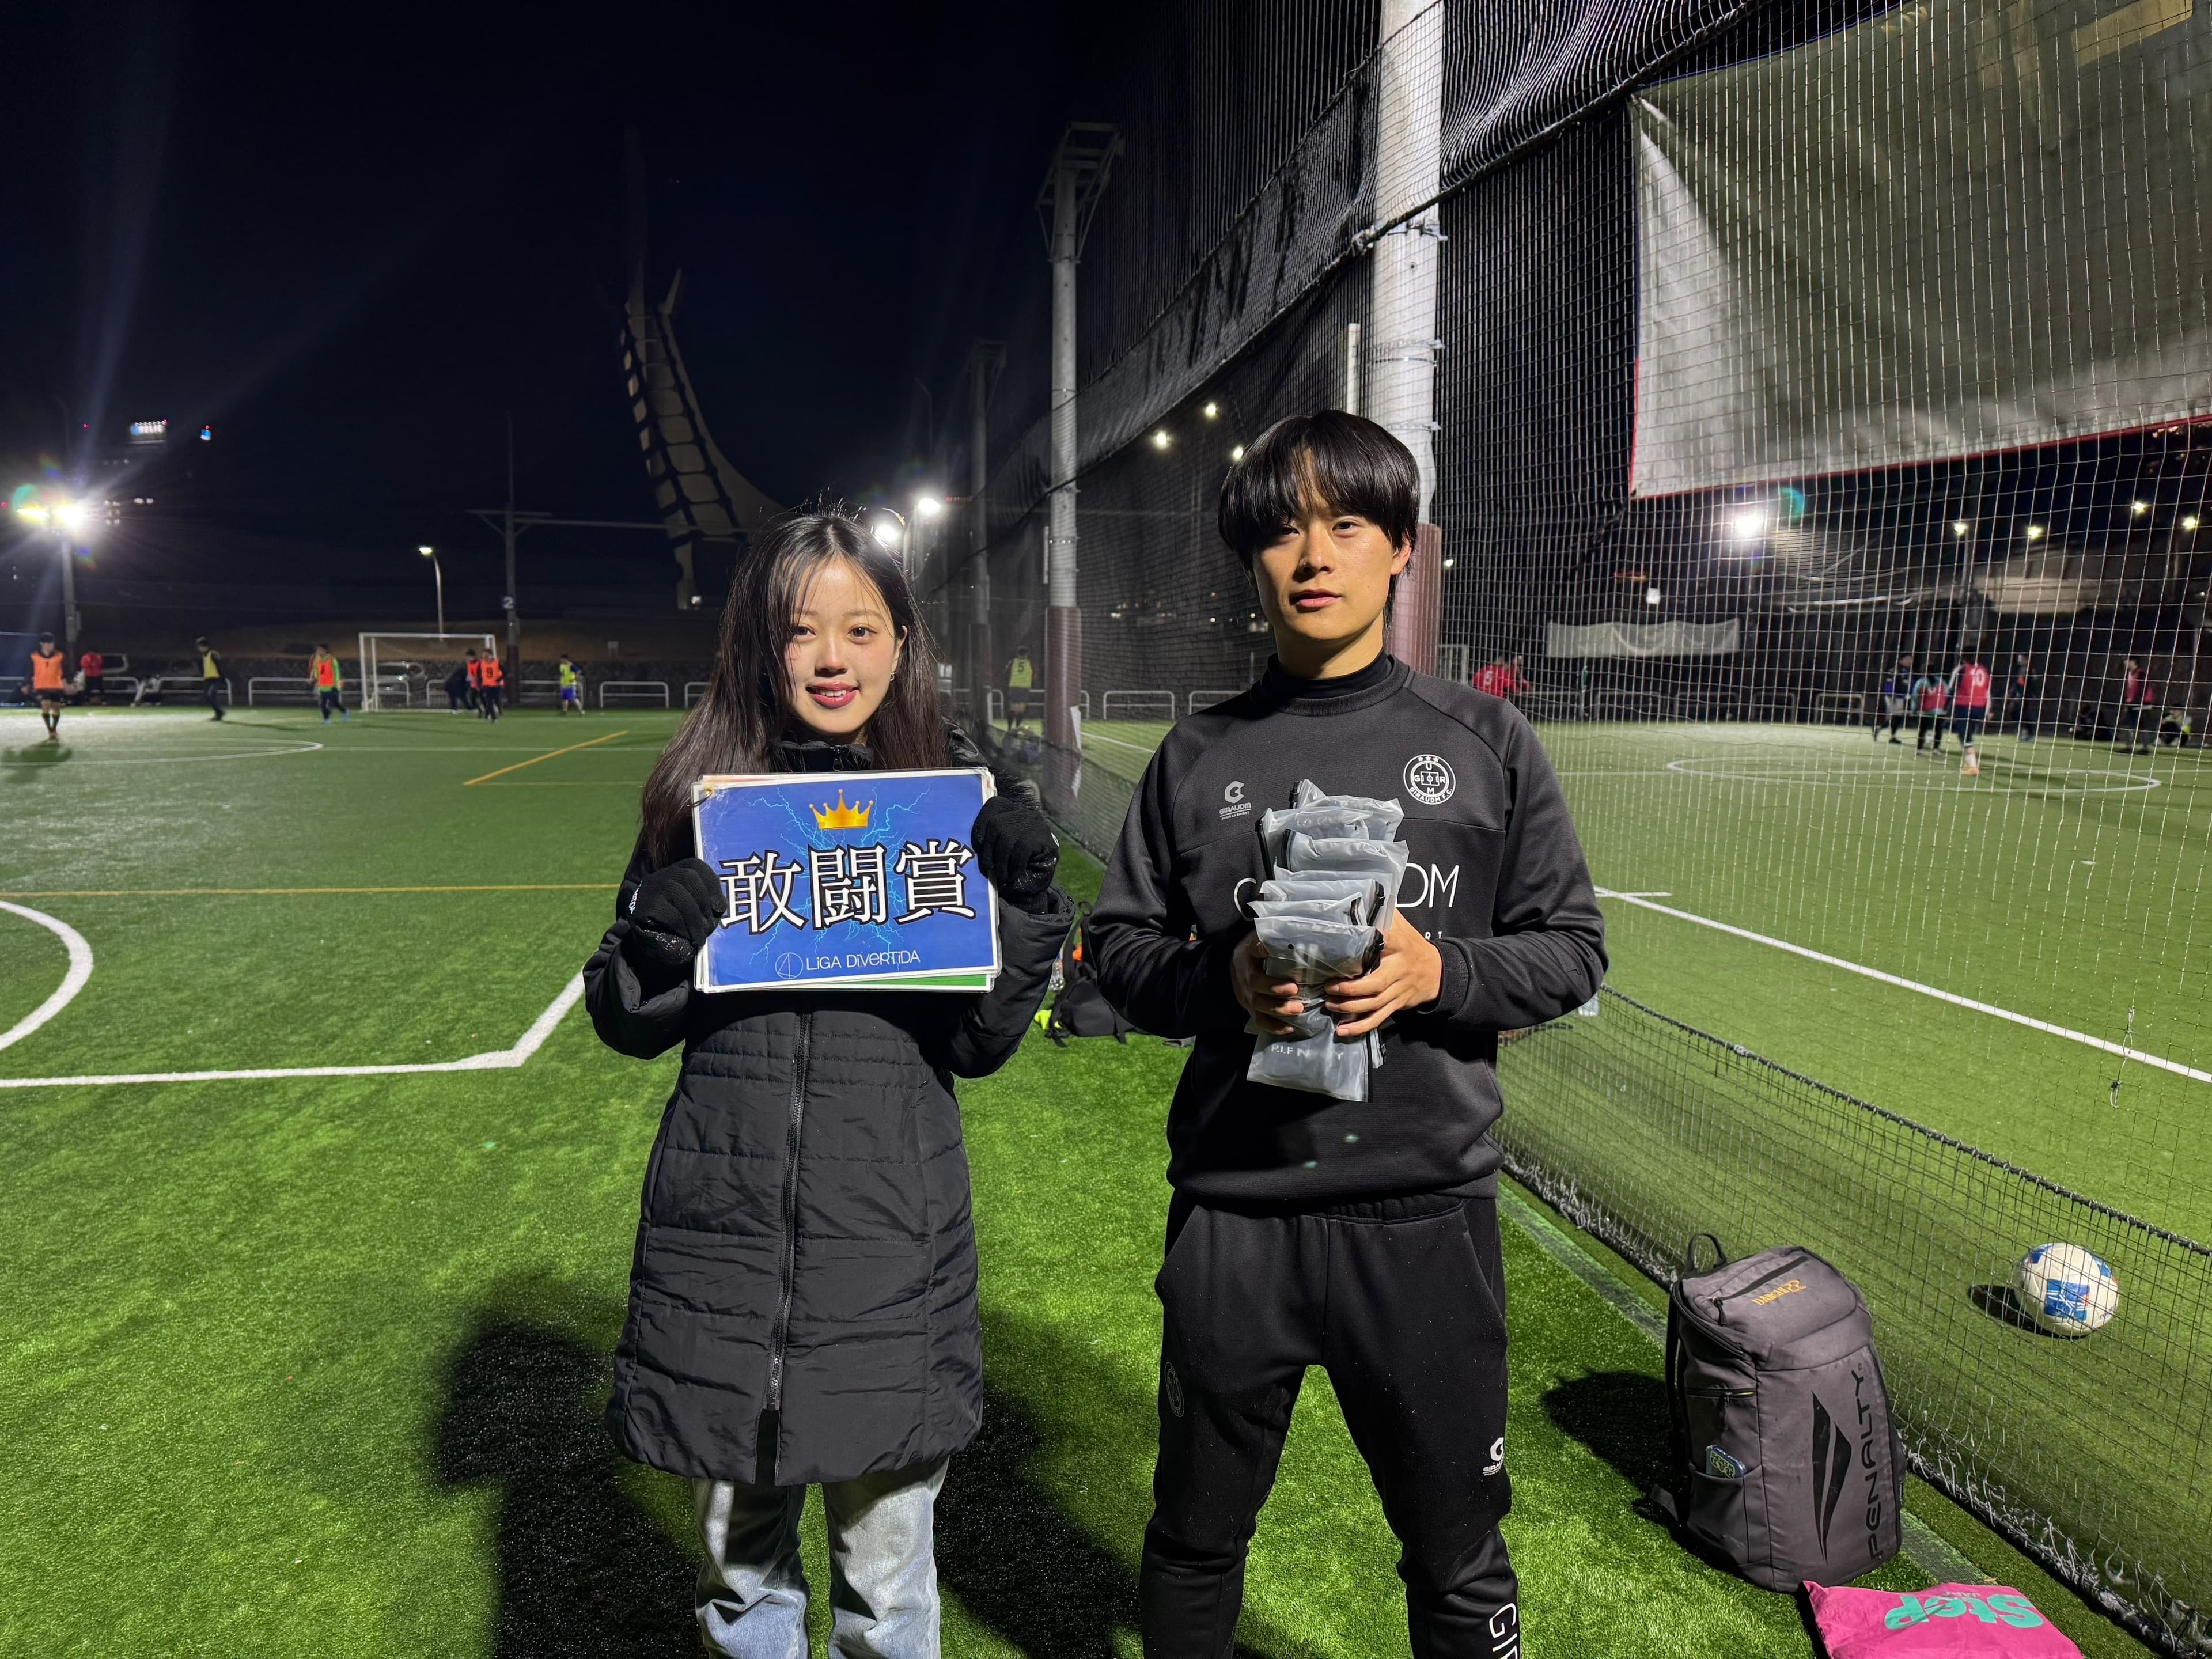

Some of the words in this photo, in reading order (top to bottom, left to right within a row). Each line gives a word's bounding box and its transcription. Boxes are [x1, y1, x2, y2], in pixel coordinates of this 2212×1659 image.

[504, 597, 513, 609] 2
[1018, 662, 1024, 673] 5
[1410, 787, 1441, 803] GIRAUDM
[719, 838, 978, 935] 敢闘賞
[1851, 1370, 1883, 1560] PENALTY
